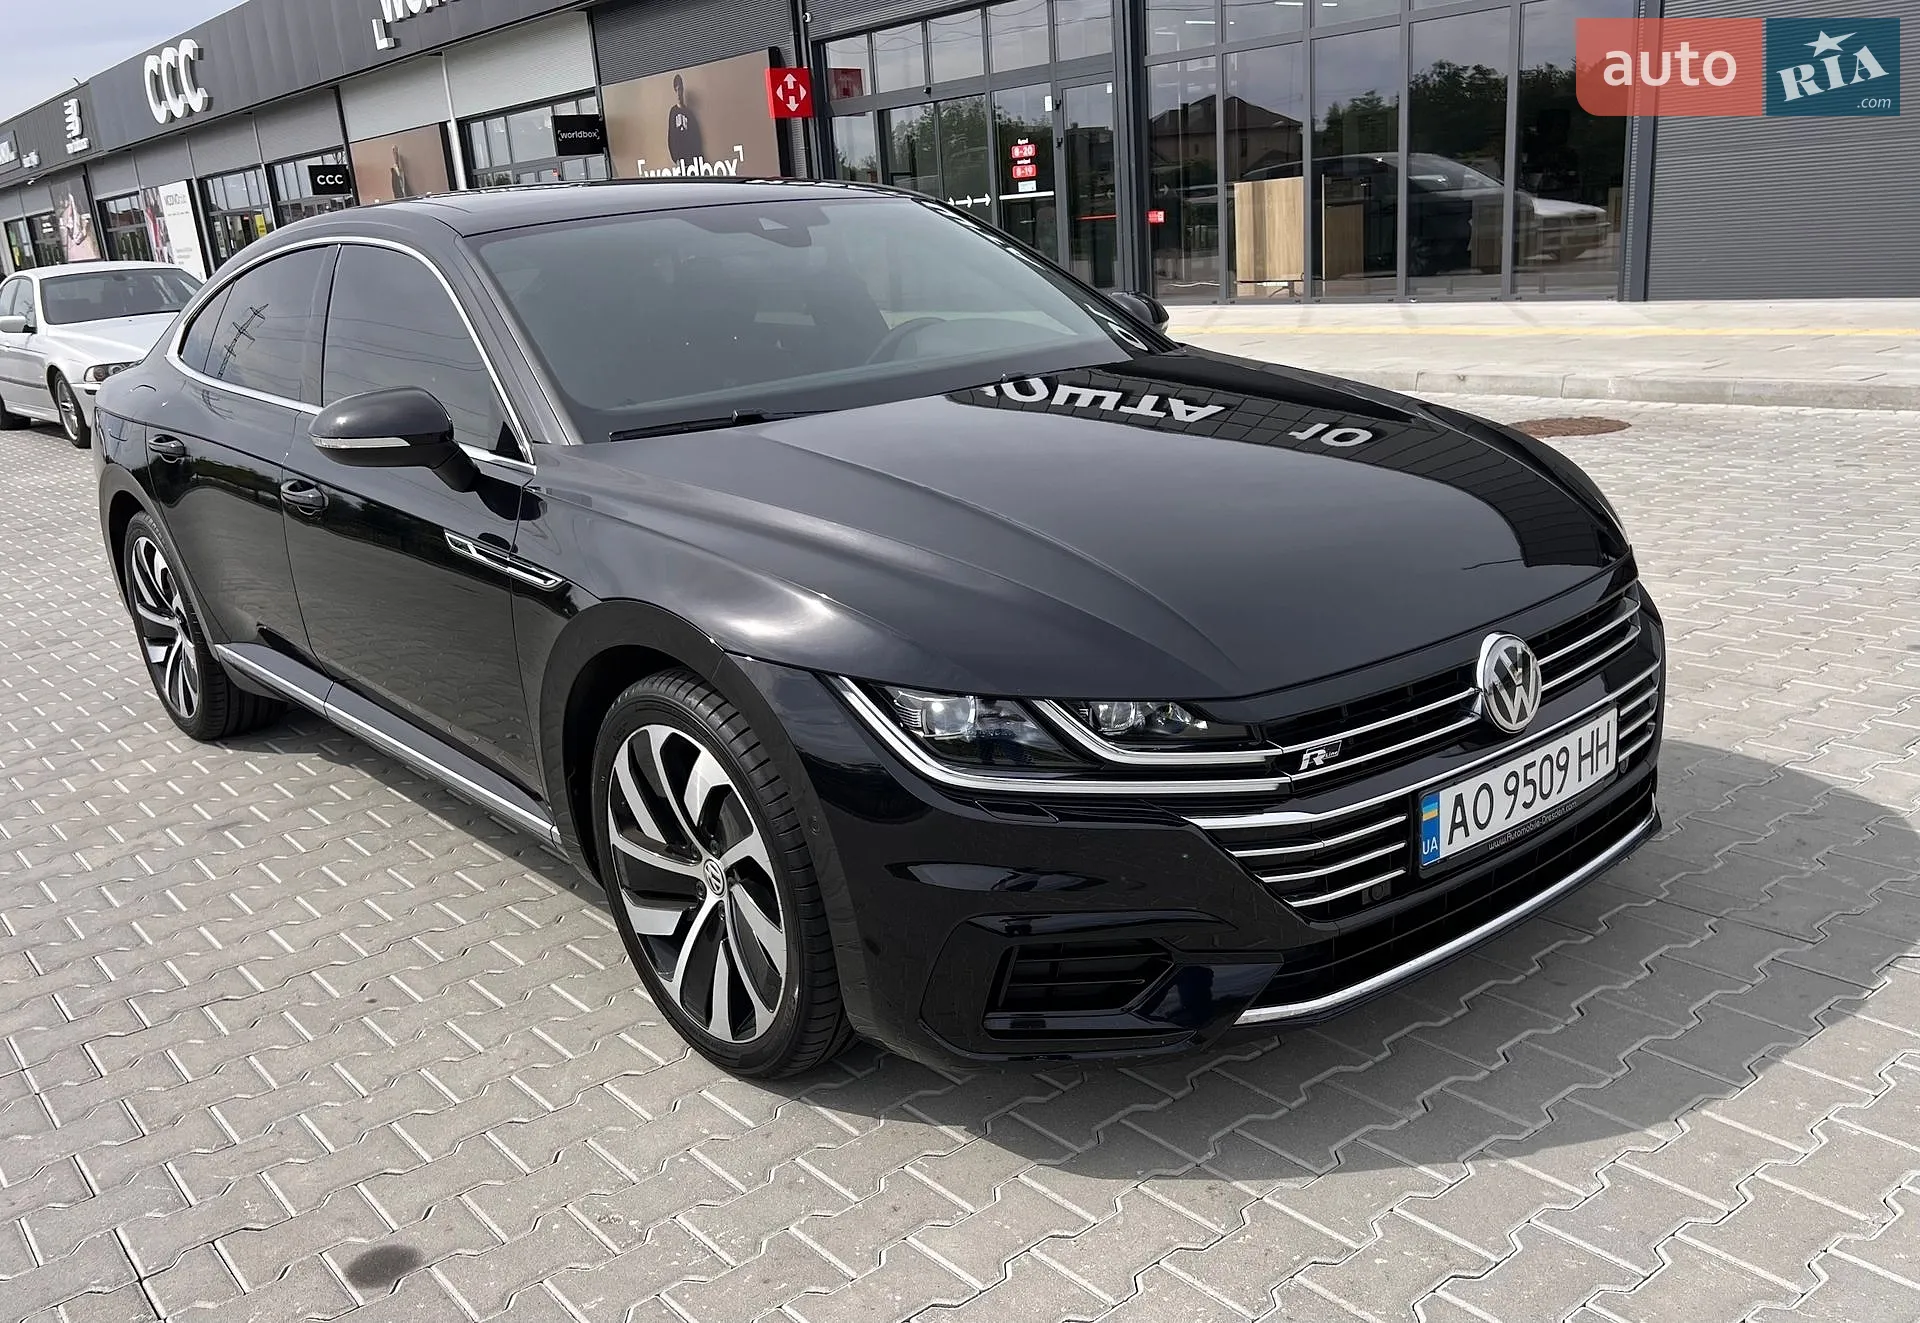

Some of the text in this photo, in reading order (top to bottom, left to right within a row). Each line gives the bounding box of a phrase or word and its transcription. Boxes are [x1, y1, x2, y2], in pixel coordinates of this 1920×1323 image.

[144, 38, 208, 124] CCC
[316, 174, 344, 185] CCC
[1447, 719, 1613, 846] AO 9509 HH
[1422, 837, 1439, 856] UA
